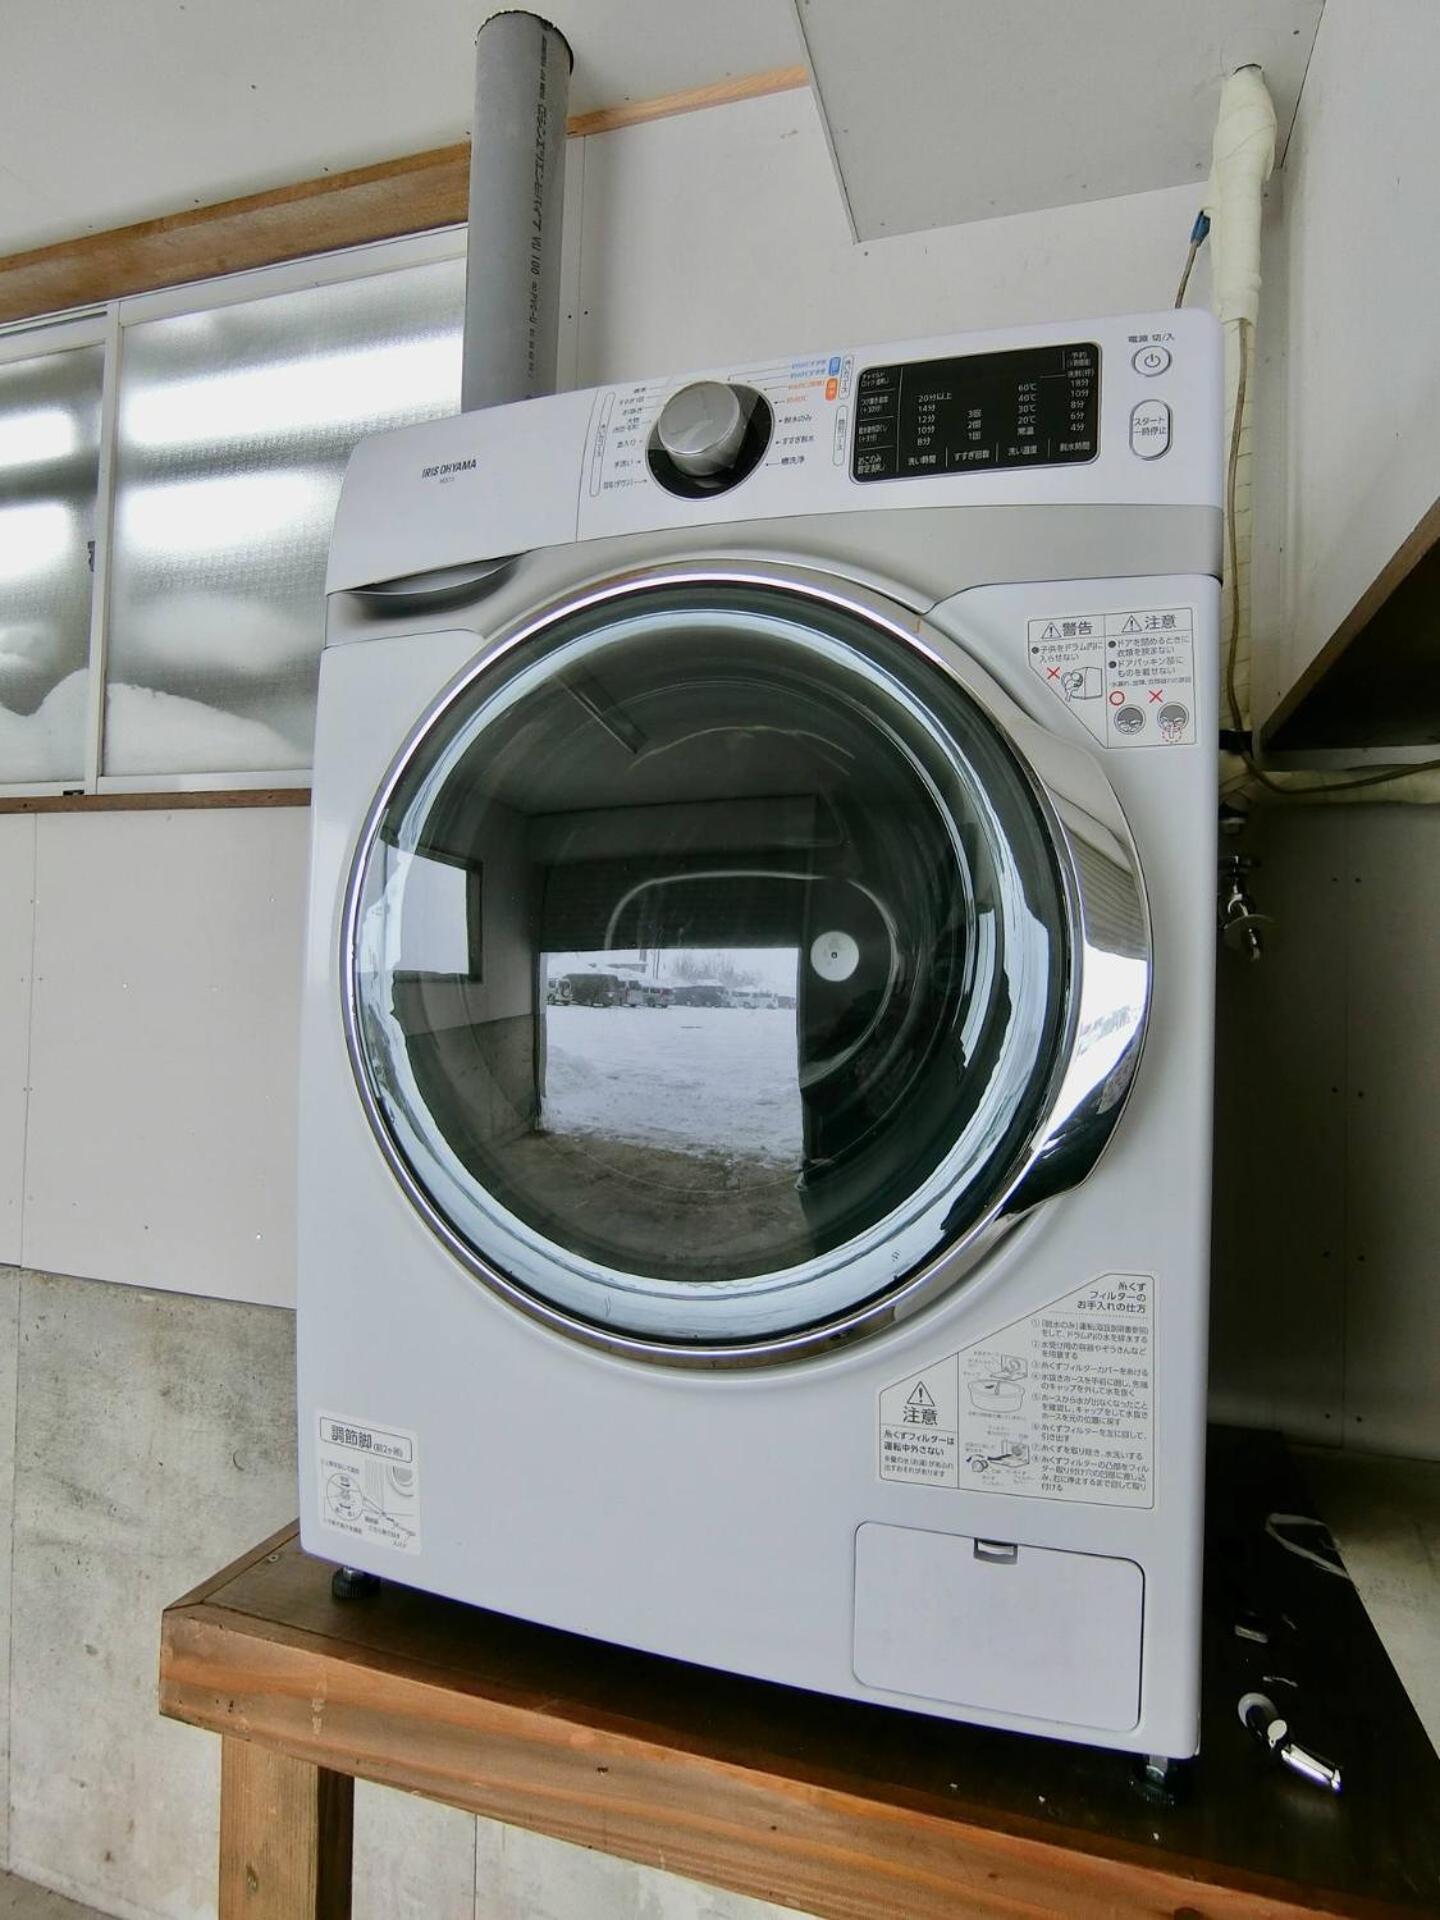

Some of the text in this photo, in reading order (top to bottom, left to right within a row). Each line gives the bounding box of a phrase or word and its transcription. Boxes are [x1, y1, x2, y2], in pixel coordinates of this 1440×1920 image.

[530, 255, 542, 275] 100
[422, 459, 477, 479] IRIS OHYAMA
[1062, 621, 1093, 636] 警告
[1145, 614, 1177, 630] 注意
[1118, 1280, 1146, 1292] 糸くず
[1089, 1290, 1146, 1303] フィルターの
[1077, 1300, 1146, 1314] お手入れの仕方
[903, 1408, 938, 1426] 注意
[883, 1430, 955, 1446] 糸くずフィルターは
